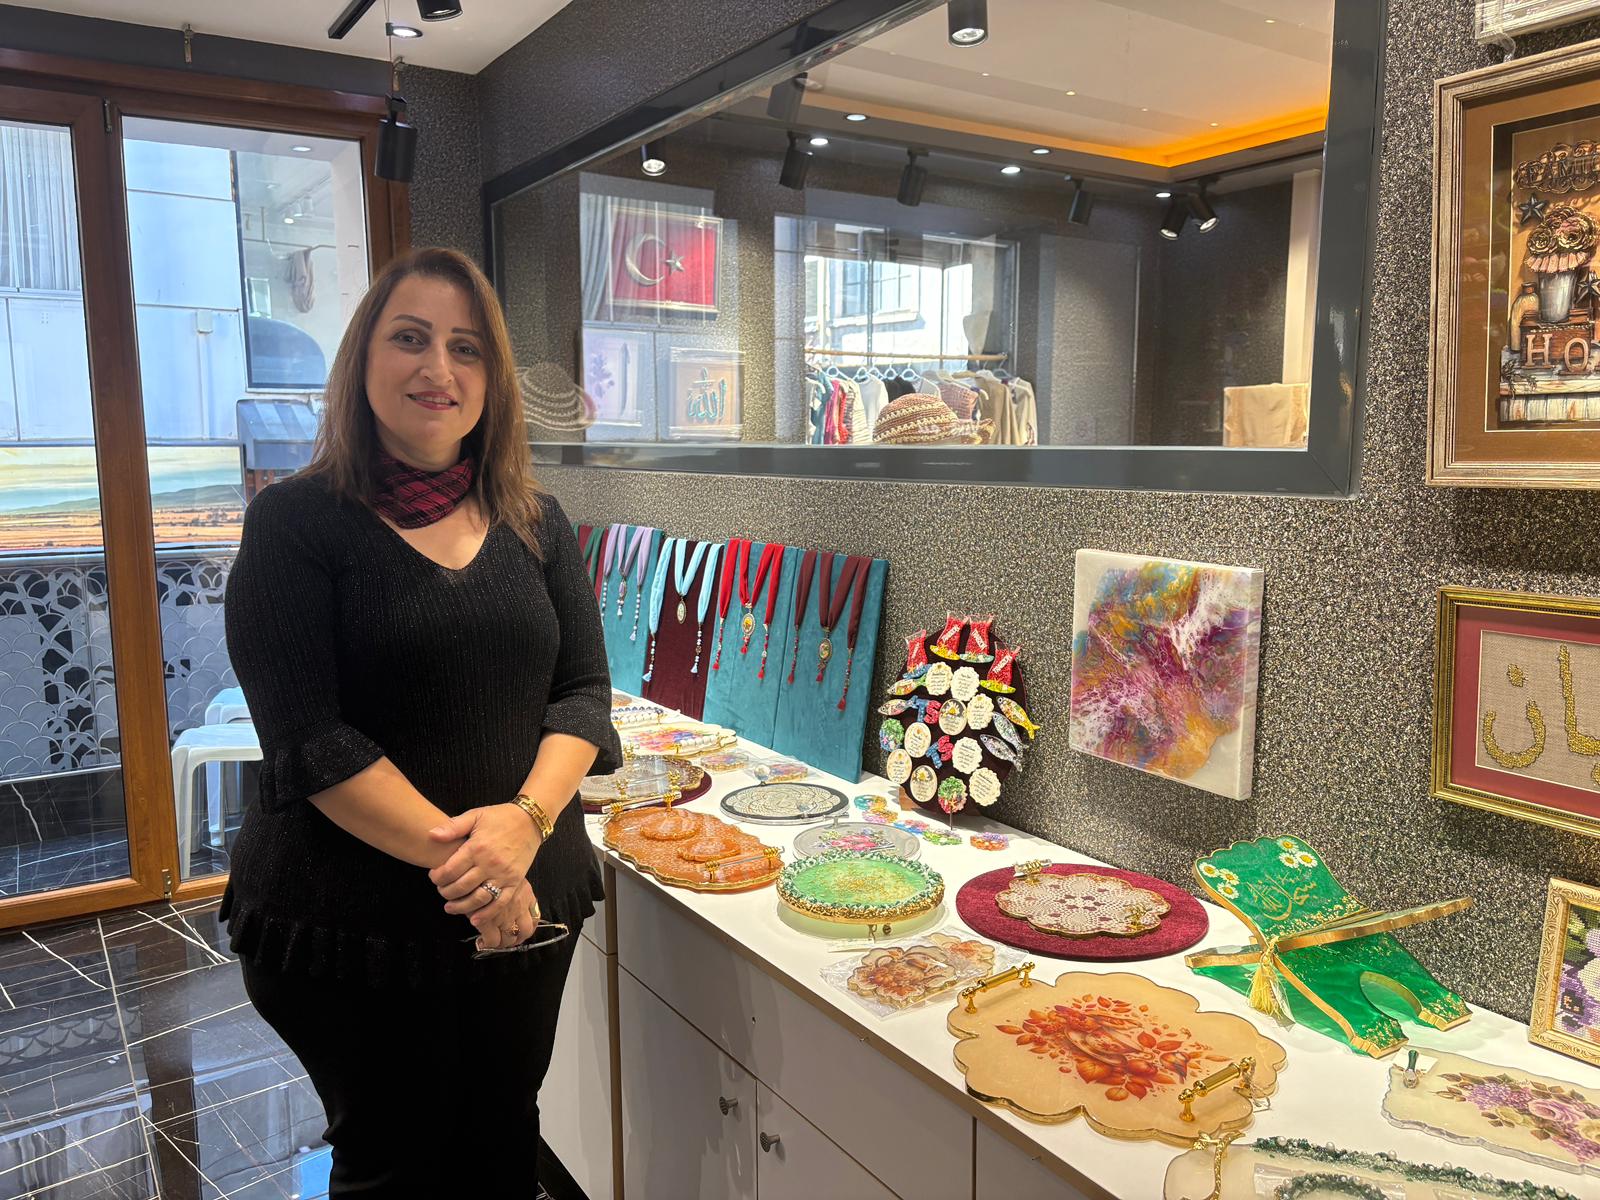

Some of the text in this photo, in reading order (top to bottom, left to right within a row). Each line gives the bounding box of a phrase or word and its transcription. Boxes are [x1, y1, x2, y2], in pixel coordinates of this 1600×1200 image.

[1525, 333, 1600, 374] HO
[914, 699, 942, 724] TS
[926, 735, 954, 769] TS
